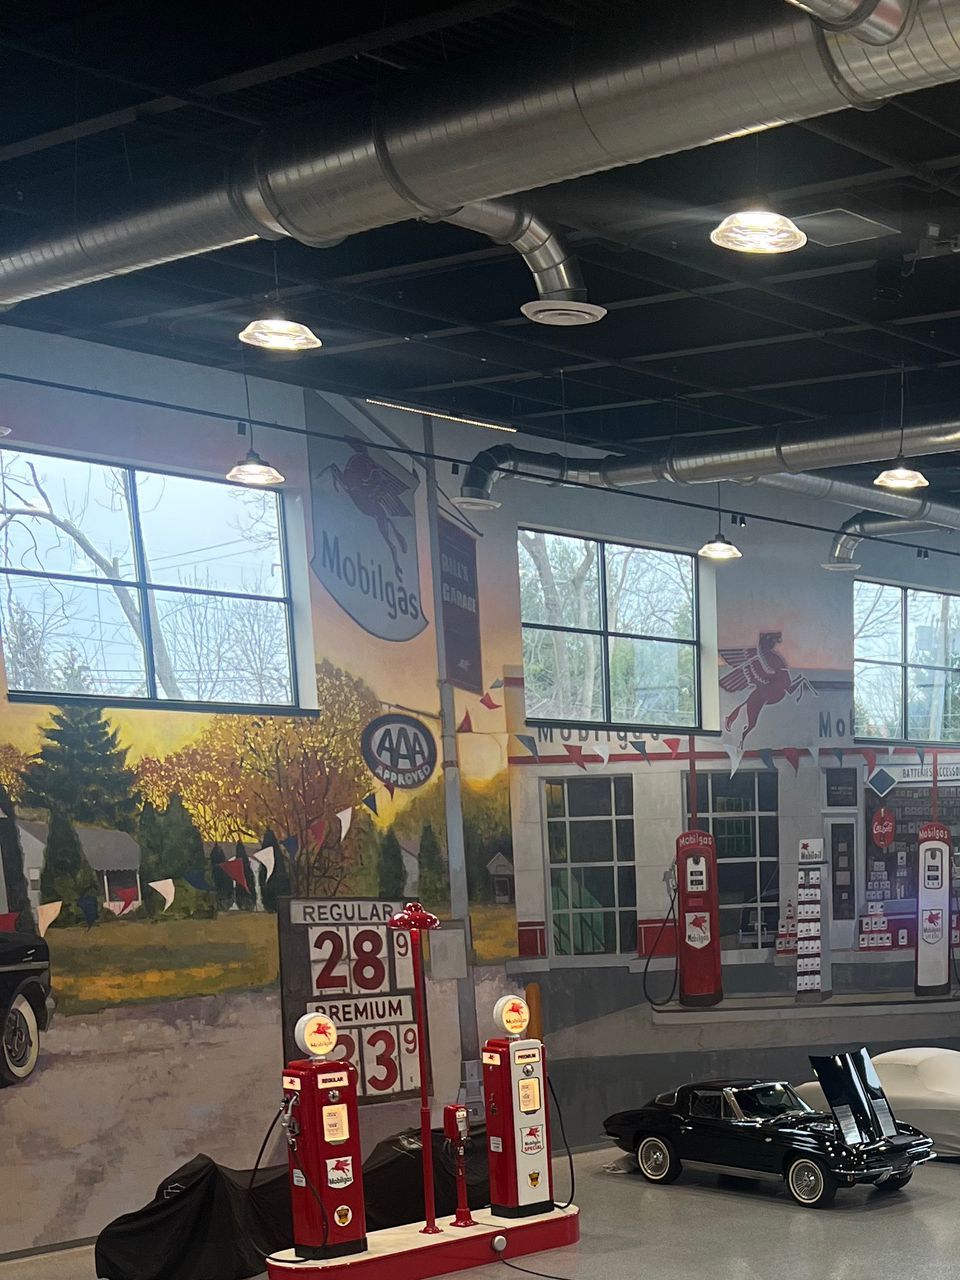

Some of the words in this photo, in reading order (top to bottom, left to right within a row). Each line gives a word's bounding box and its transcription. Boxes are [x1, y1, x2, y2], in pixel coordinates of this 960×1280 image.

[322, 530, 419, 620] Mobilgas
[376, 727, 426, 768] AAA
[375, 764, 430, 785] APPROVED
[679, 833, 713, 847] Mobilgas
[918, 827, 948, 840] Mobilgas
[303, 903, 394, 922] REGULAR
[313, 929, 386, 991] 28
[396, 932, 409, 957] 9
[403, 1028, 417, 1054] 9
[321, 1076, 344, 1084] REGULAR
[329, 1176, 353, 1185] Mobilgas
